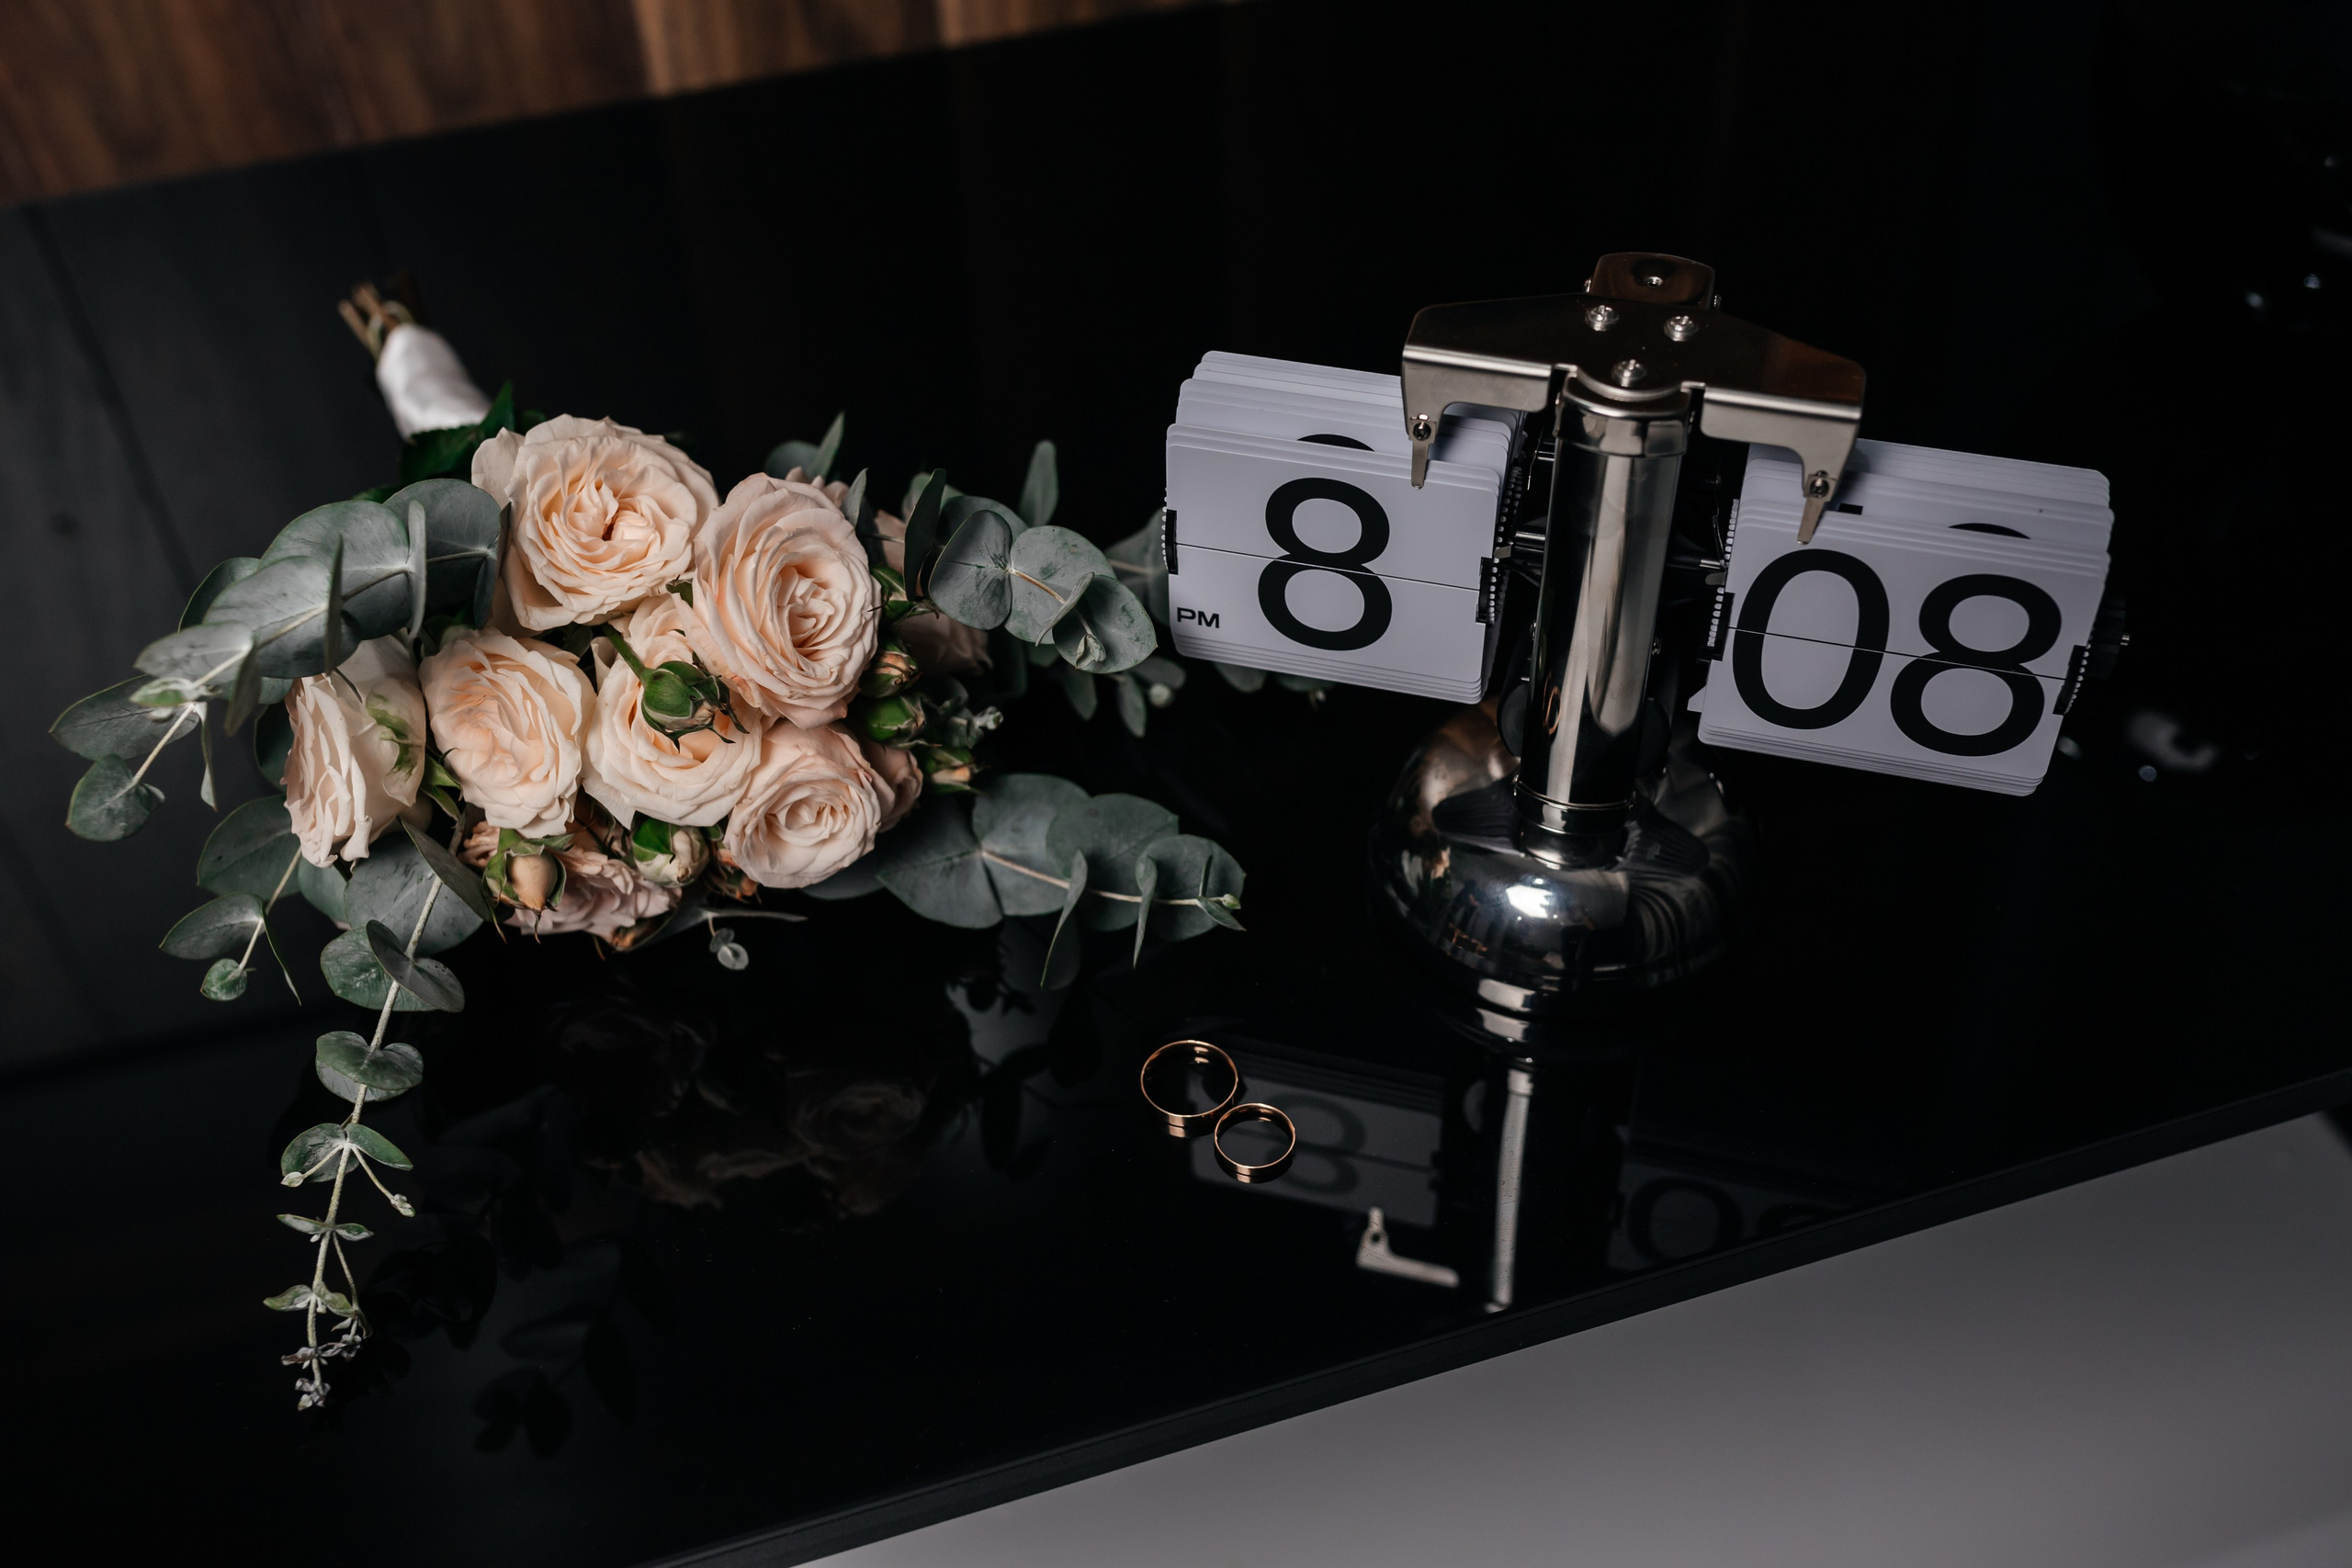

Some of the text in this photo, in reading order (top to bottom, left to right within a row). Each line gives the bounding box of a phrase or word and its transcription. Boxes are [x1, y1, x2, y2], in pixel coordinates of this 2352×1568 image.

[1177, 606, 1220, 629] PM
[1258, 477, 1393, 651] 8
[1732, 548, 2063, 757] 08
